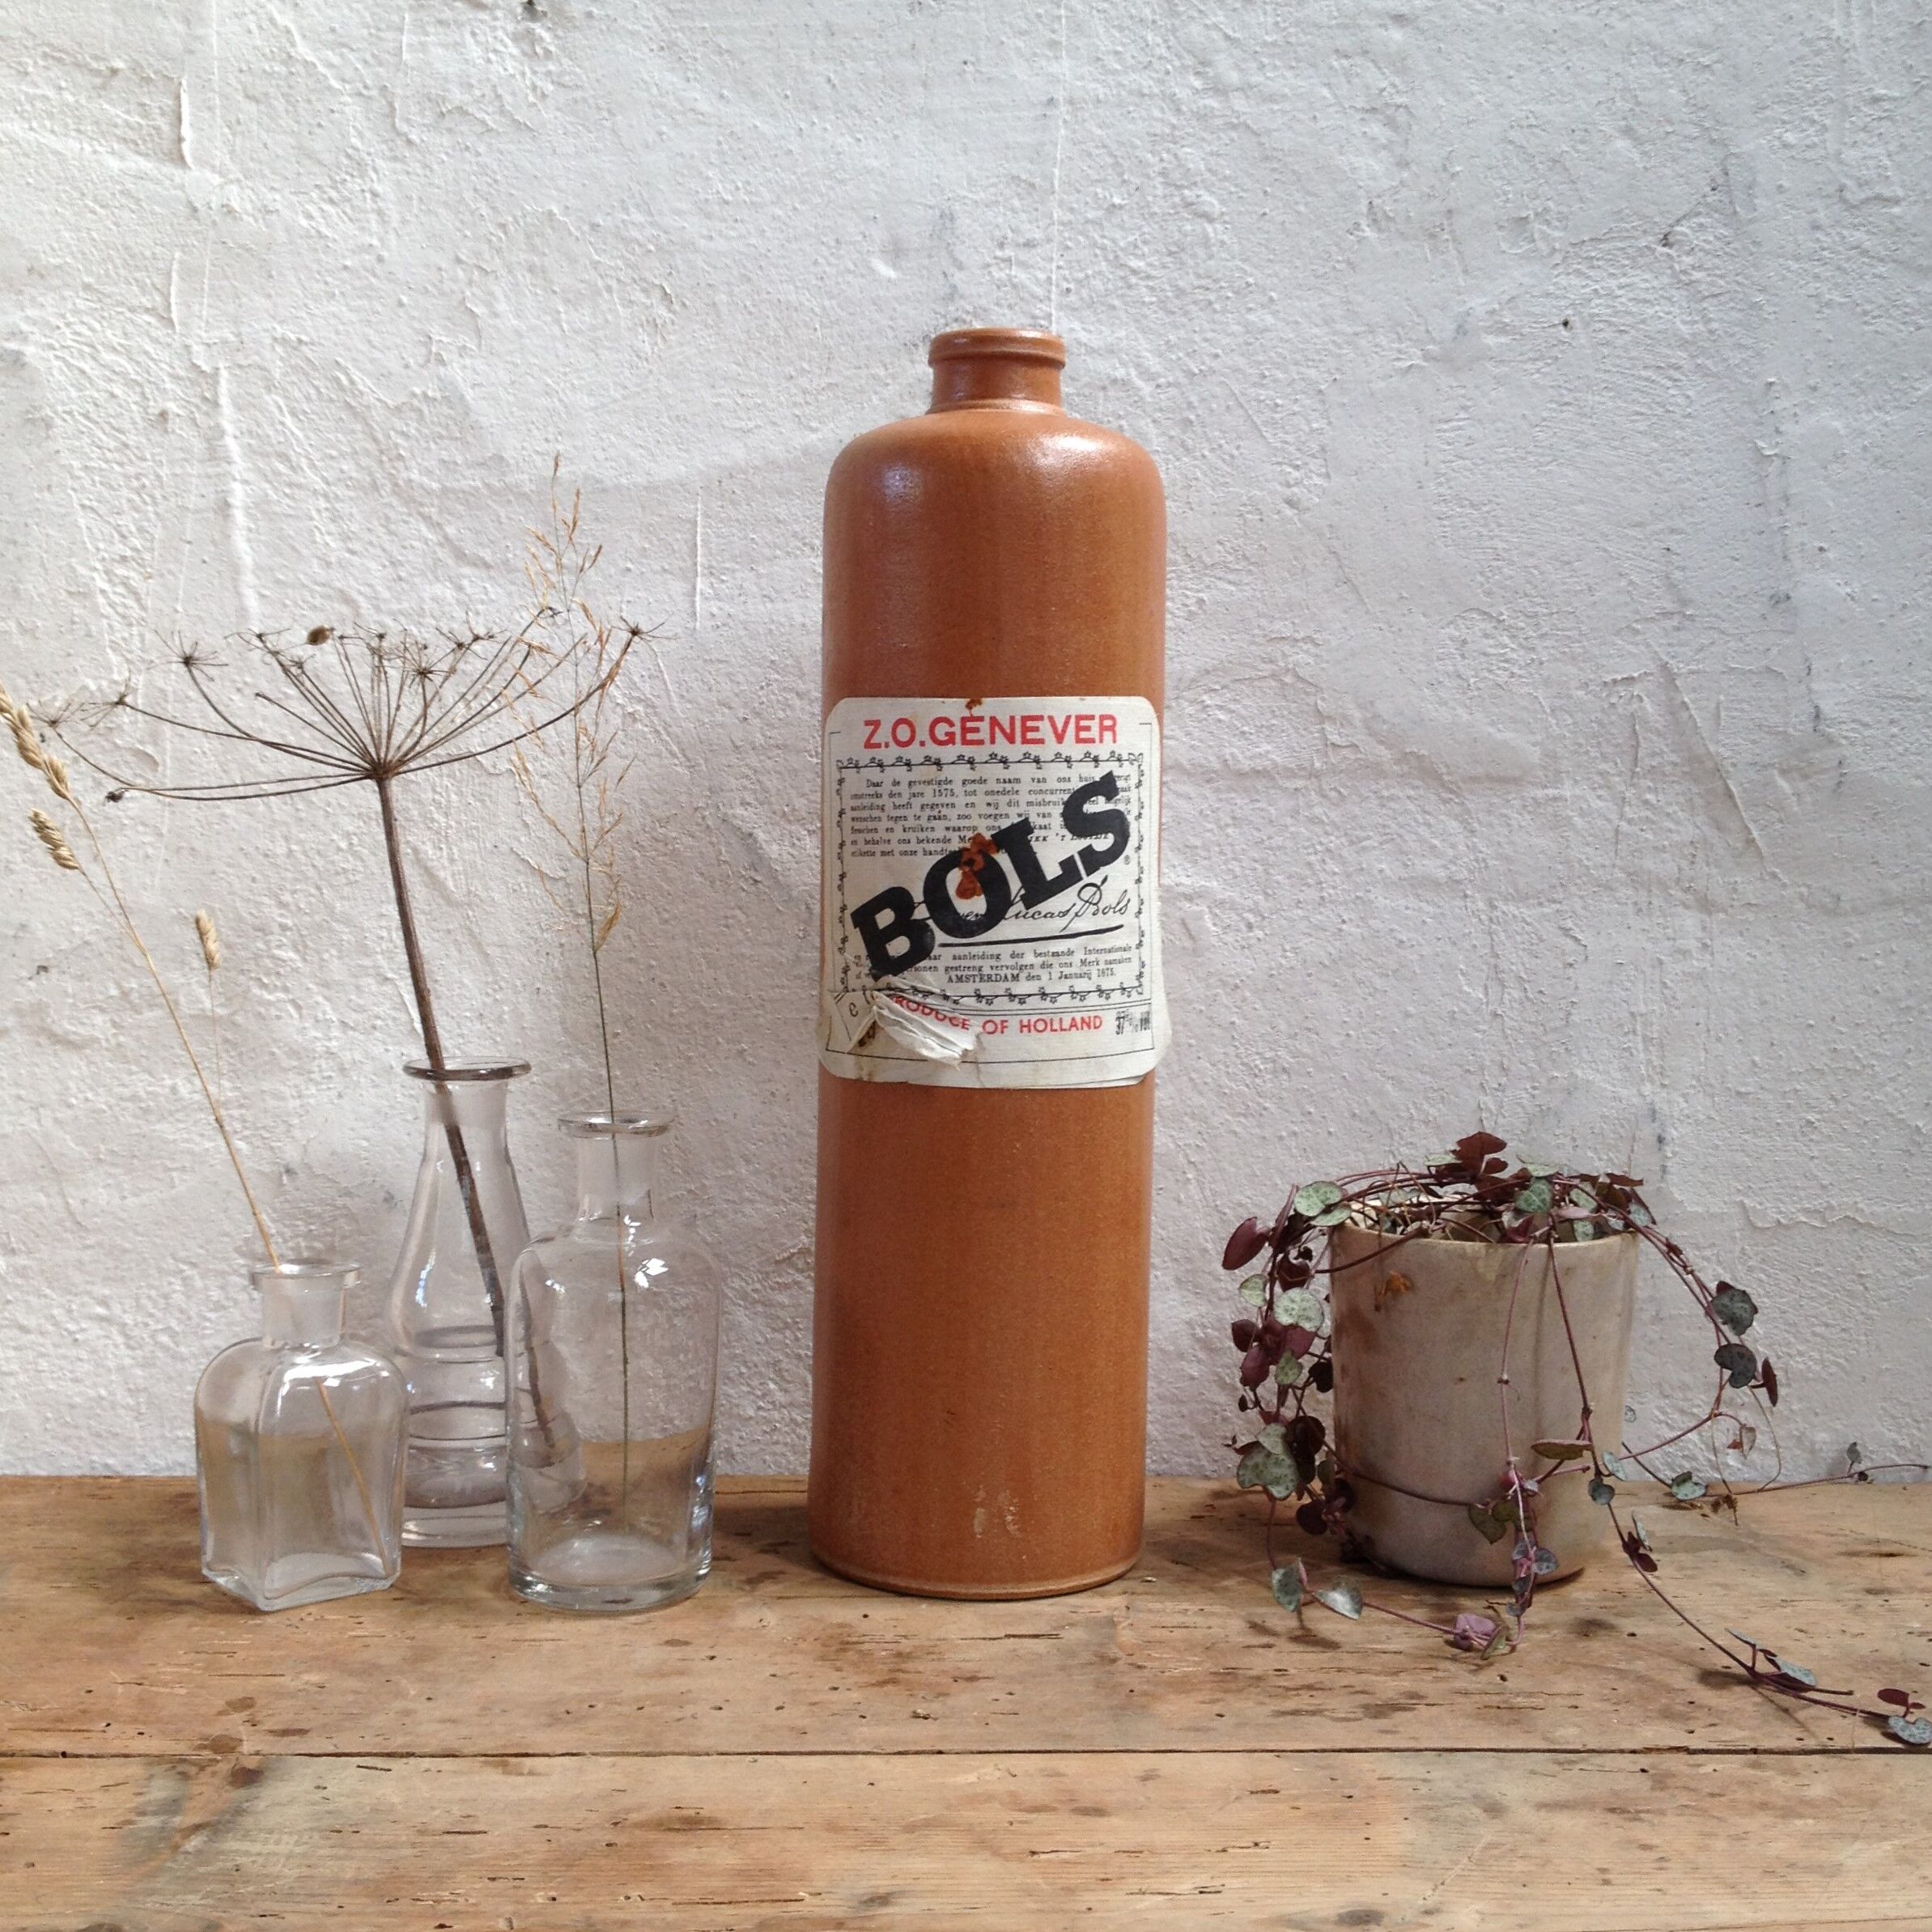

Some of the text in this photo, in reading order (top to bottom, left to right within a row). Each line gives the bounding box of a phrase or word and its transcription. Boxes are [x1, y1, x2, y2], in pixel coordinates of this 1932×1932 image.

[866, 779, 884, 788] Daar
[891, 778, 901, 787] de
[907, 777, 953, 789] gevestigde
[962, 776, 987, 787] goede
[888, 789, 902, 799] den
[908, 791, 925, 800] jare
[964, 788, 978, 796] tot
[984, 788, 1020, 796] onedele
[893, 801, 912, 810] heeft
[920, 803, 956, 813] gegeven
[1007, 799, 1020, 808] dit
[887, 813, 908, 824] tegen
[913, 813, 922, 822] te
[957, 813, 972, 821] zoo
[979, 813, 1010, 824] voegen
[1036, 811, 1052, 819] van
[902, 825, 936, 833] kruiken
[945, 825, 979, 834] waarop
[986, 824, 1001, 832] ons
[864, 835, 891, 846] behalve
[916, 835, 952, 845] bekende
[880, 847, 894, 856] met
[851, 770, 1131, 982] BOLS
[1059, 874, 1132, 932] Bols
[952, 952, 1001, 962] aanleiding
[1009, 950, 1025, 959] der
[945, 965, 983, 974] gestreng
[990, 961, 1034, 972] vervolgen
[1040, 960, 1053, 970] die
[1059, 961, 1073, 969] ons
[1080, 958, 1101, 968] Merk
[947, 973, 1020, 984] AMSTERDAM
[1025, 972, 1042, 981] den
[893, 996, 971, 1031] RODUCE
[982, 1019, 1009, 1035] OF
[1019, 1015, 1102, 1034] HOLLAND
